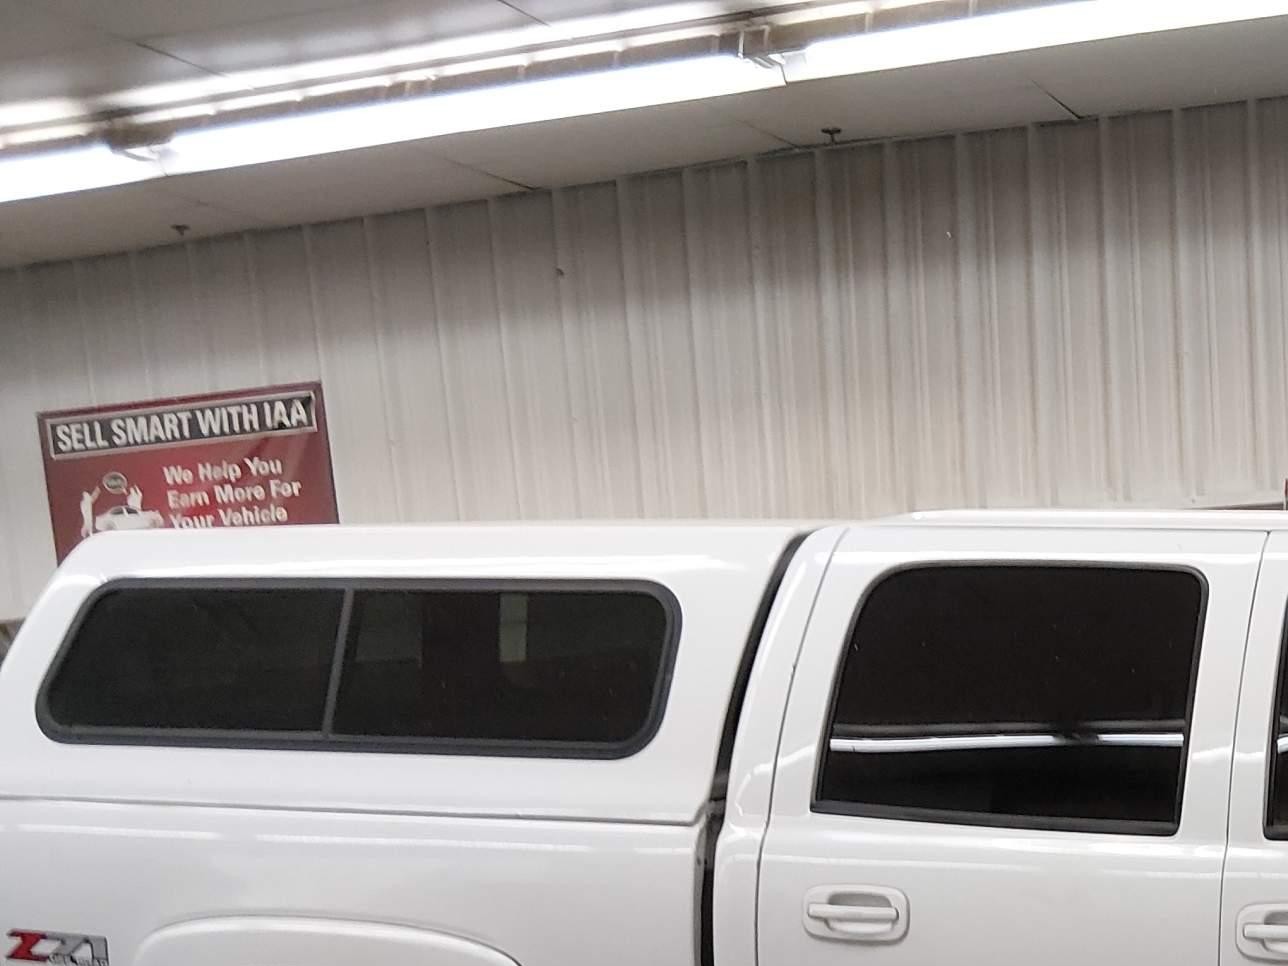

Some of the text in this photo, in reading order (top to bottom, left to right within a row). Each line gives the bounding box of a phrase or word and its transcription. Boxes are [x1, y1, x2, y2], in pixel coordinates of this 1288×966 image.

[55, 399, 309, 453] SELL SMART WITH IAA
[163, 456, 283, 486] We Help You
[167, 479, 302, 510] Earn More For
[168, 503, 289, 529] Your Vehicle
